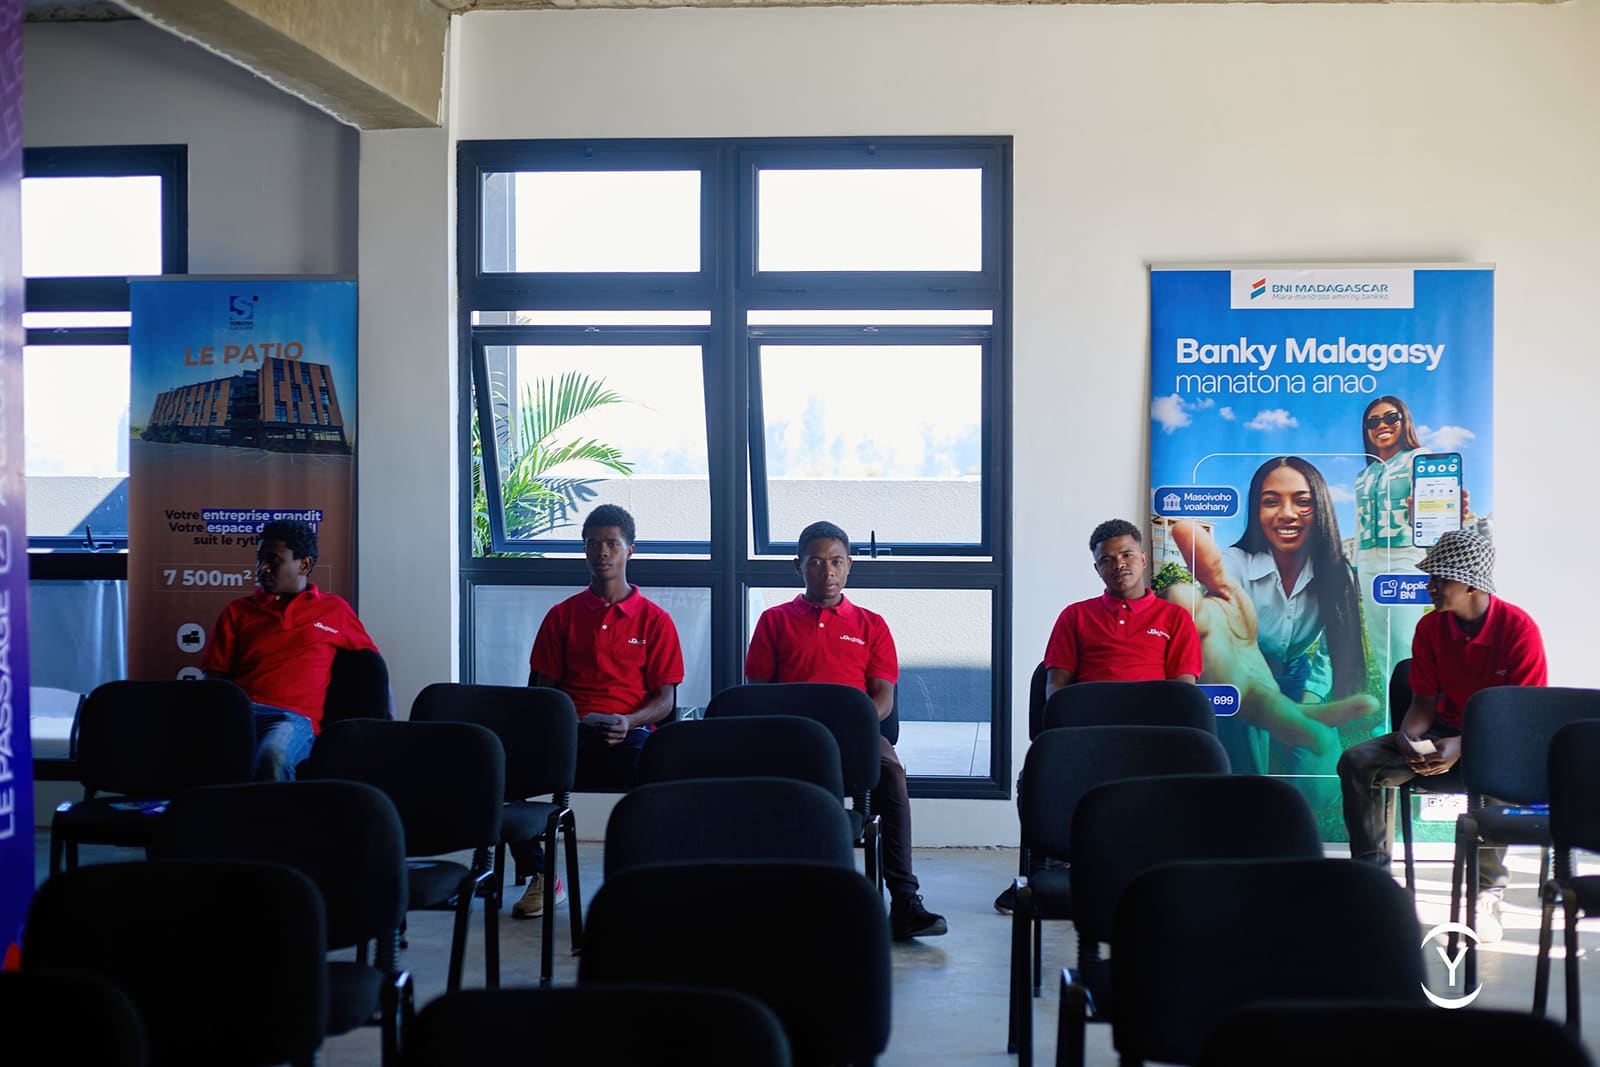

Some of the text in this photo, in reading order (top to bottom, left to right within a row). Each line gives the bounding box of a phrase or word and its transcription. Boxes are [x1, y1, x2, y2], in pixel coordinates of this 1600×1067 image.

[1272, 284, 1389, 293] BNI MADAGASCAR
[184, 341, 304, 367] LE PATIO
[1176, 337, 1445, 371] Banky Malagasy
[1176, 373, 1377, 394] manatona anao
[1184, 493, 1232, 502] Masoivoho
[1184, 503, 1229, 512] voalohany
[165, 510, 200, 520] Votre
[203, 510, 270, 522] entreprise
[169, 522, 204, 532] Votre
[207, 524, 253, 535] espace
[193, 535, 218, 545] suit
[221, 535, 233, 545] le
[163, 569, 177, 586] 7
[182, 569, 252, 586] 500m²
[1214, 696, 1234, 705] 699
